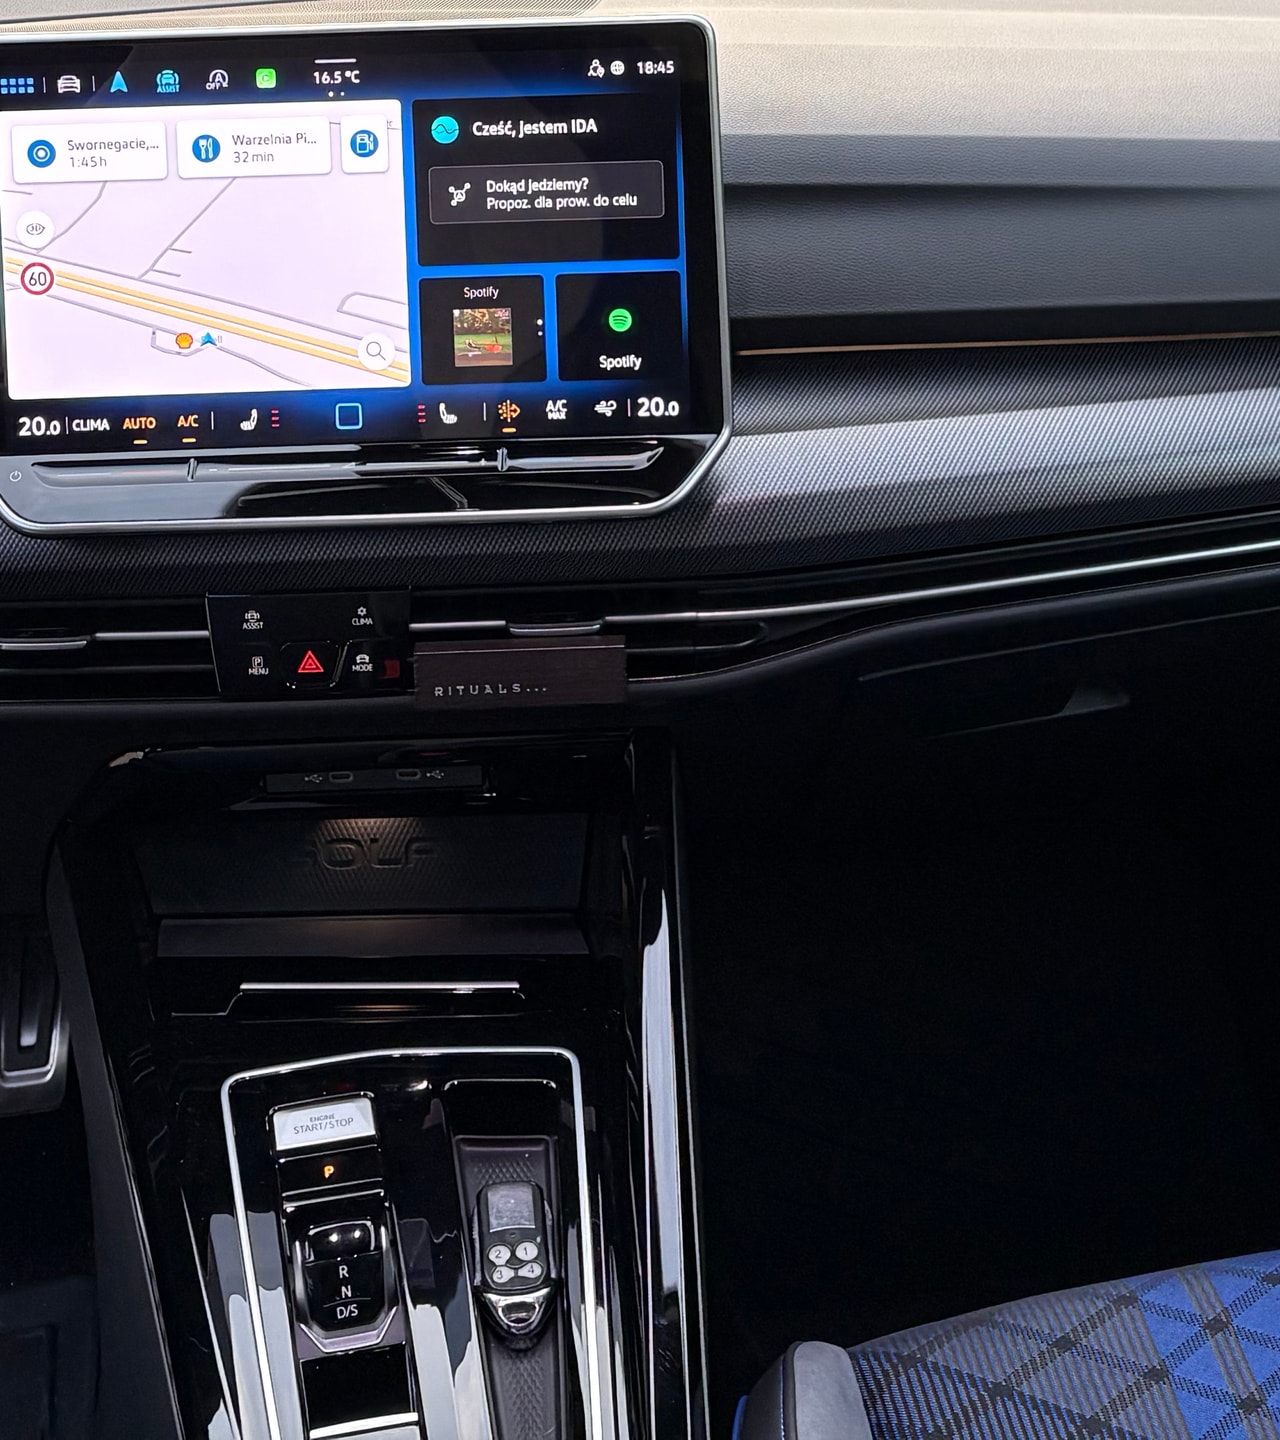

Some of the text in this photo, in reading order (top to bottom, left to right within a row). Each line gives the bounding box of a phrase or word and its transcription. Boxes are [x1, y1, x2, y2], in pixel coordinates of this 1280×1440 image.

[637, 60, 675, 75] 18:45
[313, 69, 342, 86] 16.5
[472, 117, 598, 139] Cześć, jestem IDA
[231, 132, 293, 147] Warzelnia
[69, 156, 97, 169] 1:45
[234, 151, 274, 164] 32 min
[486, 178, 589, 194] Dokąd jedziemy?
[486, 193, 637, 211] Propoz. dla prow. do celu
[28, 272, 47, 287] 60
[463, 287, 499, 299] Spotify
[599, 355, 642, 371] Spotify
[545, 399, 567, 411] A/C
[637, 396, 679, 417] 20.0
[177, 413, 199, 428] A/C
[547, 411, 566, 420] MAX
[18, 416, 61, 436] 20.0
[72, 417, 110, 432] CLIMA
[122, 416, 157, 430] AUTO
[242, 621, 263, 630] ASSIST
[351, 616, 373, 626] CLIMA
[248, 666, 269, 676] MENU
[351, 662, 374, 672] MODE
[293, 1117, 354, 1135] START/STOP
[324, 1165, 335, 1178] P
[494, 1249, 502, 1259] 2
[339, 1265, 349, 1278] R
[496, 1269, 503, 1280] 3
[527, 1263, 534, 1275] 4
[342, 1285, 352, 1298] N
[336, 1305, 358, 1320] D/S
